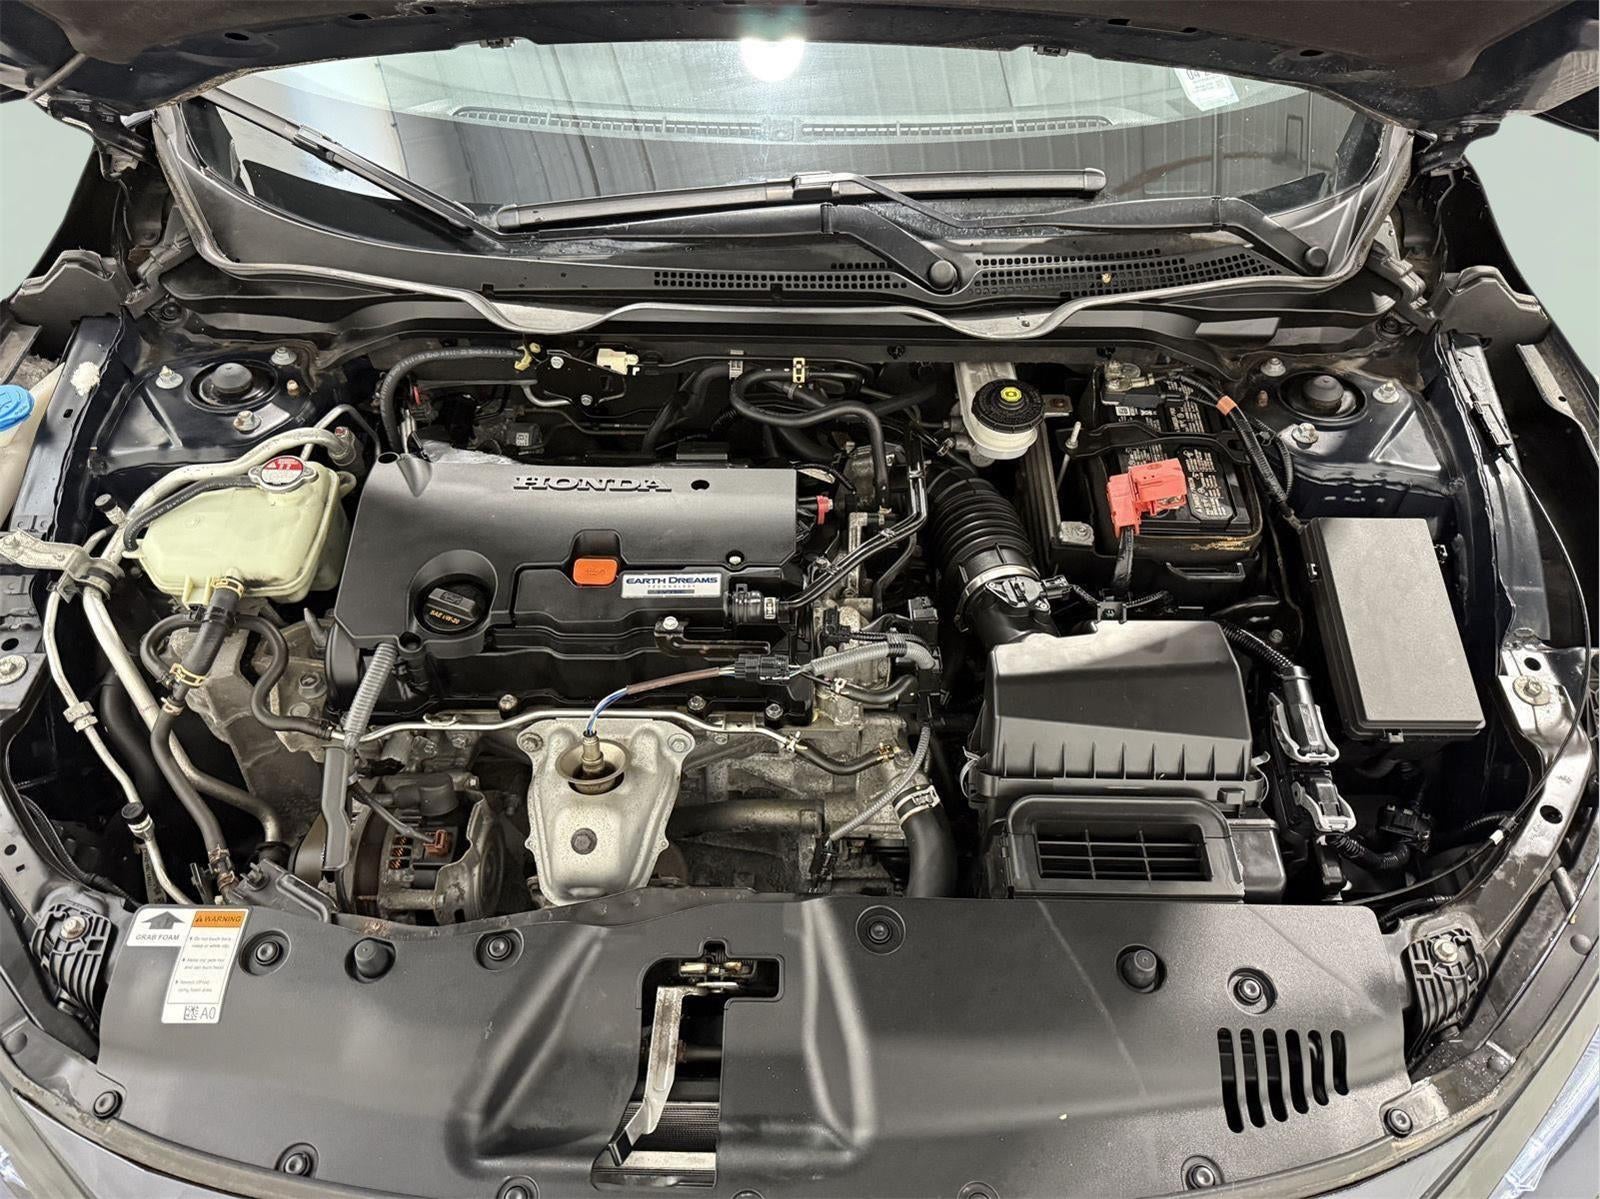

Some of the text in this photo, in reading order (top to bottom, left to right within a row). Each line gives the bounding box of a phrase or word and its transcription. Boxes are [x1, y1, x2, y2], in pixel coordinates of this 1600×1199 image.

[513, 476, 672, 492] HONDA
[625, 576, 718, 585] EARTH DREAMS
[204, 915, 242, 923] WARNING
[135, 933, 180, 941] GRAB FOAM
[199, 1006, 217, 1020] A0
